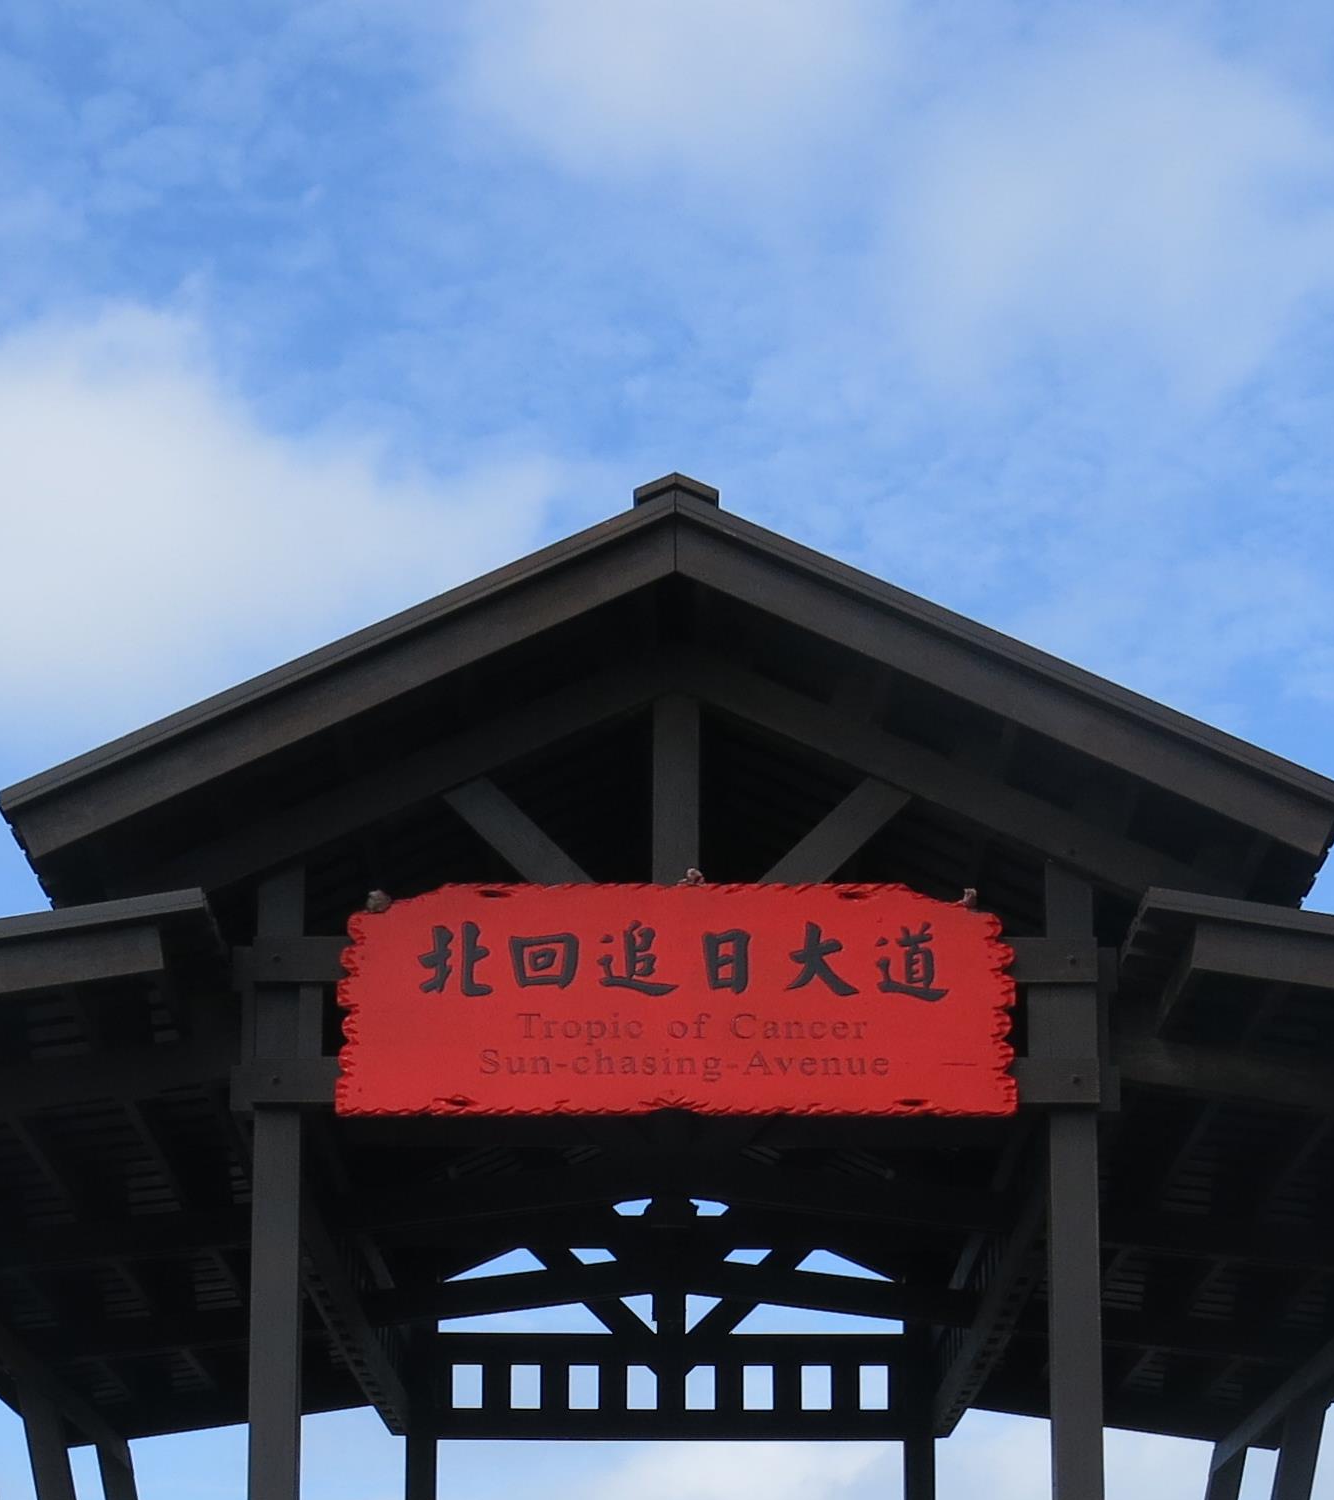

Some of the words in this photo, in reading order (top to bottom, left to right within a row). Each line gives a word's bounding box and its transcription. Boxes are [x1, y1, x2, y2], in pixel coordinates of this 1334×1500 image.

[417, 920, 950, 1002] 北回追日大道
[517, 1012, 644, 1046] Tropic
[668, 1012, 712, 1040] of
[730, 1012, 869, 1040] Cancer
